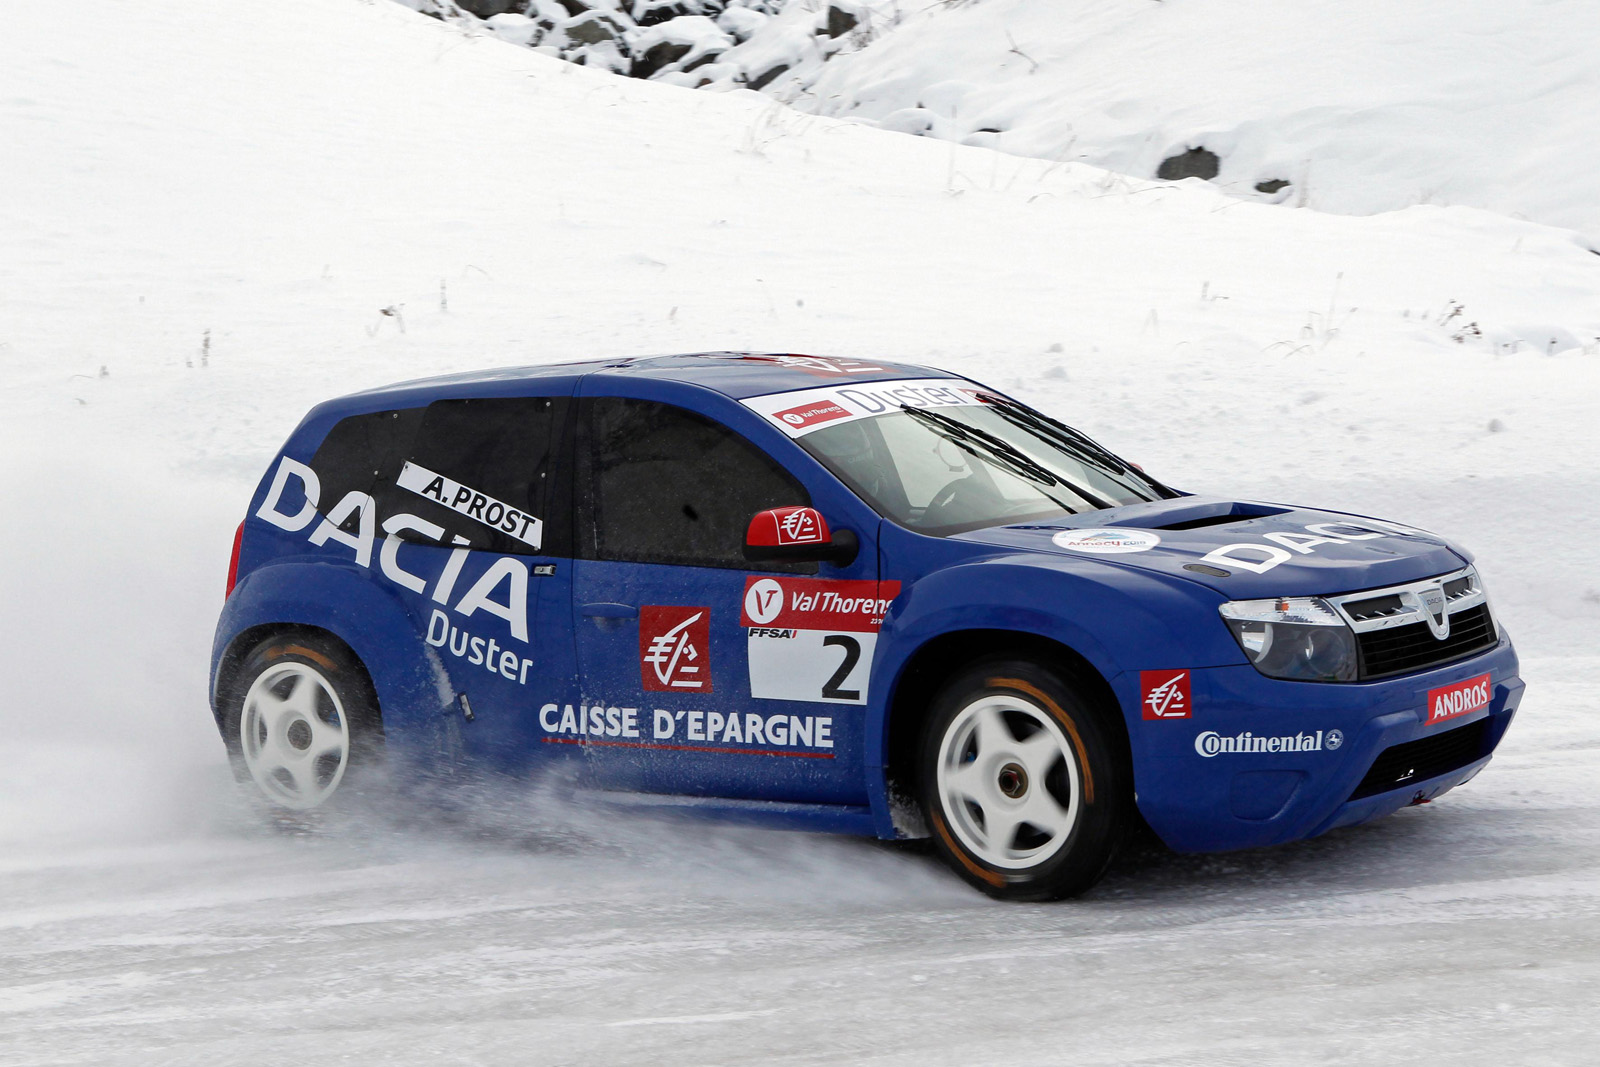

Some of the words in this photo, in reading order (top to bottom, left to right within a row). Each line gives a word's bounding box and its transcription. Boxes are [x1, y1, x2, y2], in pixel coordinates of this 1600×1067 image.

[835, 385, 968, 413] Duster
[256, 455, 529, 643] DACIA
[791, 592, 820, 612] Val
[425, 609, 533, 685] Duster
[749, 628, 791, 639] FFSA
[822, 635, 861, 701] 2
[1433, 681, 1487, 720] ANDROS
[539, 704, 640, 738] CAISSE
[654, 709, 834, 748] D'EPARGNE
[1194, 730, 1323, 758] Continental
